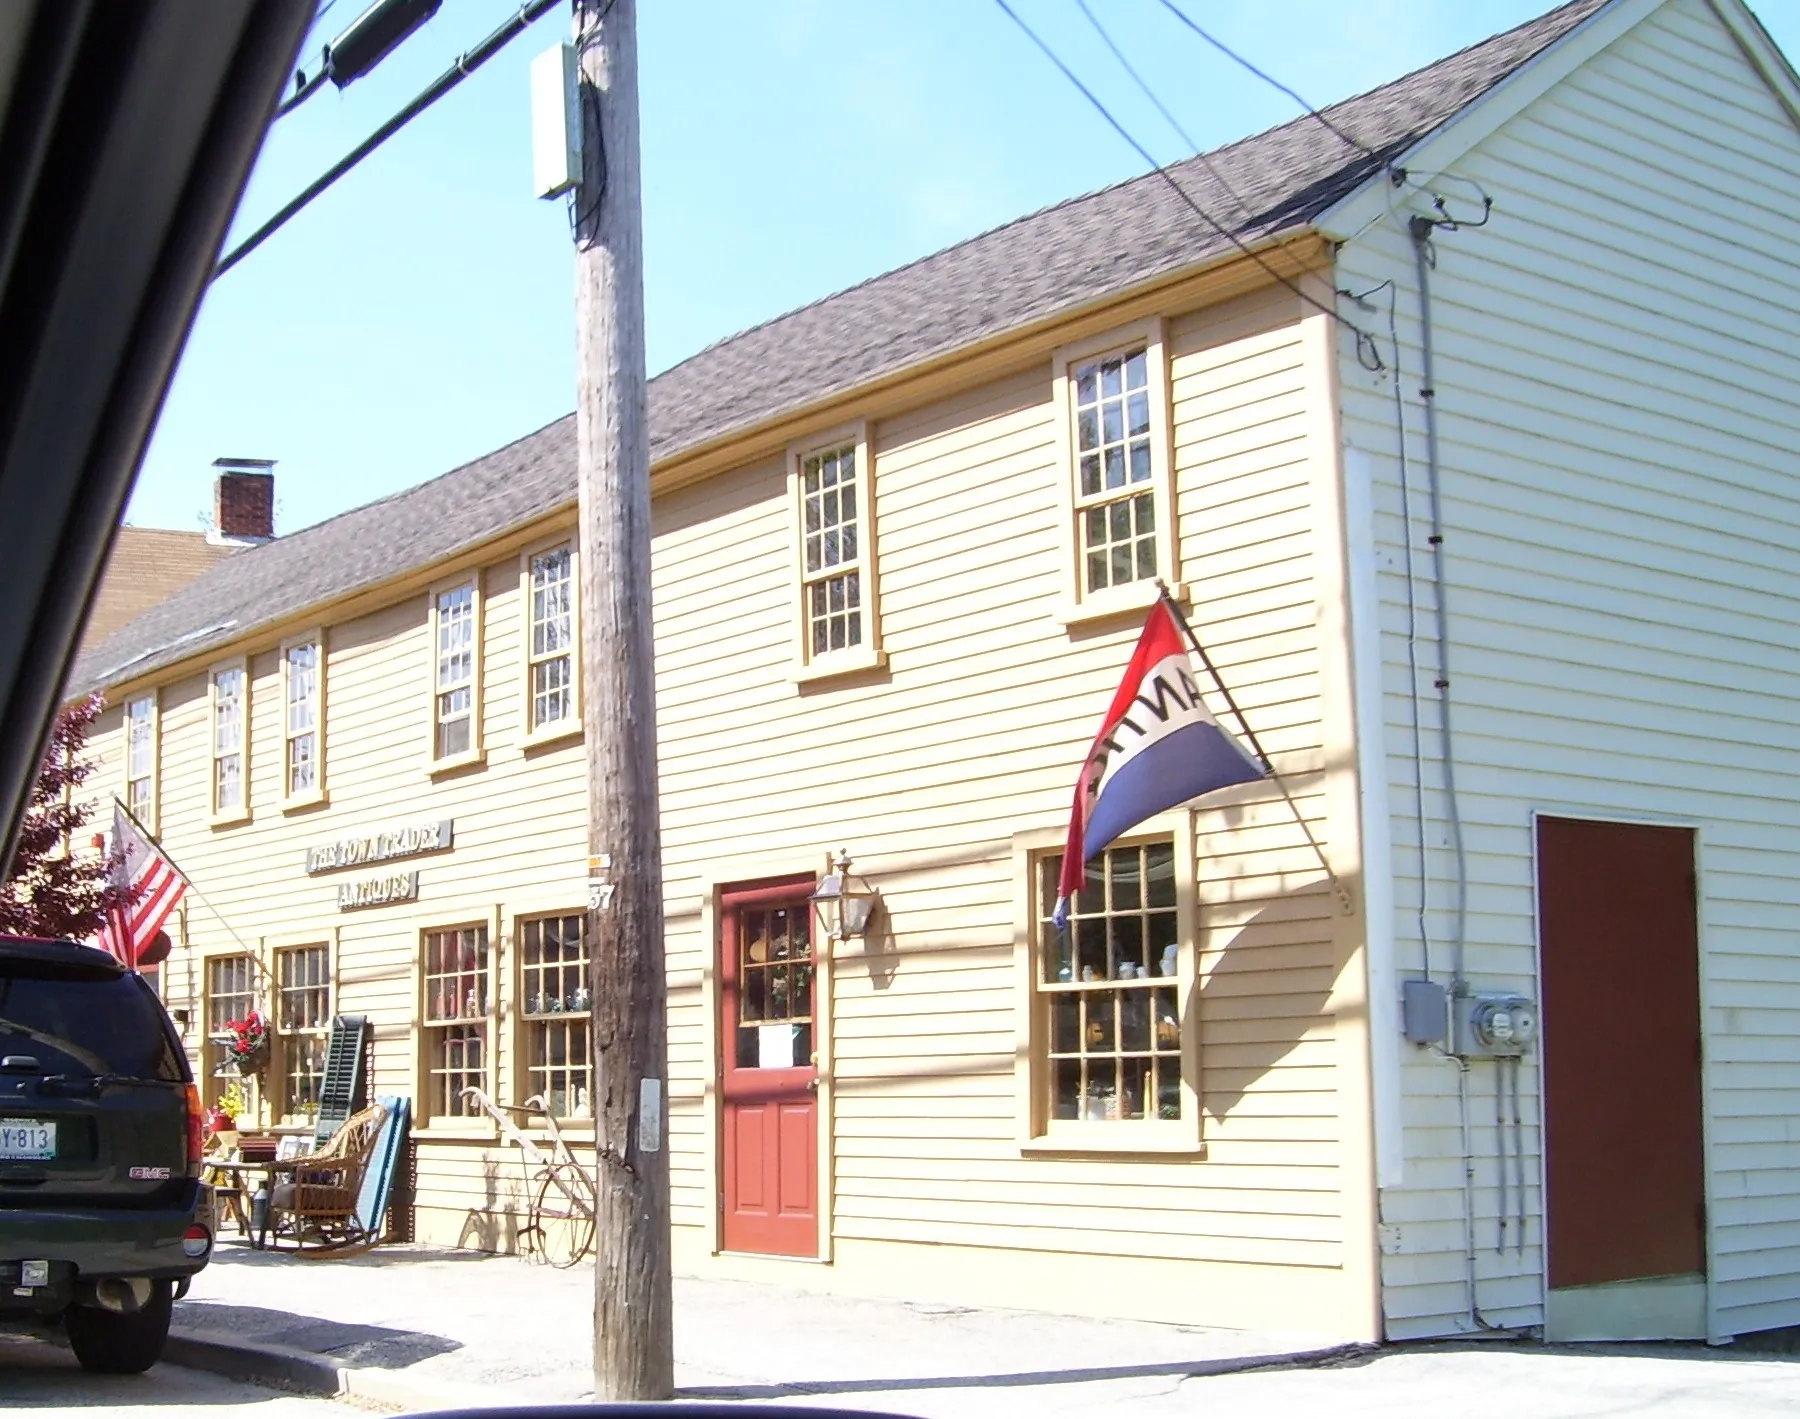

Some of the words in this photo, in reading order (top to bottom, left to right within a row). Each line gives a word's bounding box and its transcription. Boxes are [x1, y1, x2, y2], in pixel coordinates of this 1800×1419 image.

[339, 871, 411, 907] ANTIQUES
[0, 1128, 48, 1149] Y-813
[129, 1166, 171, 1180] GMC
